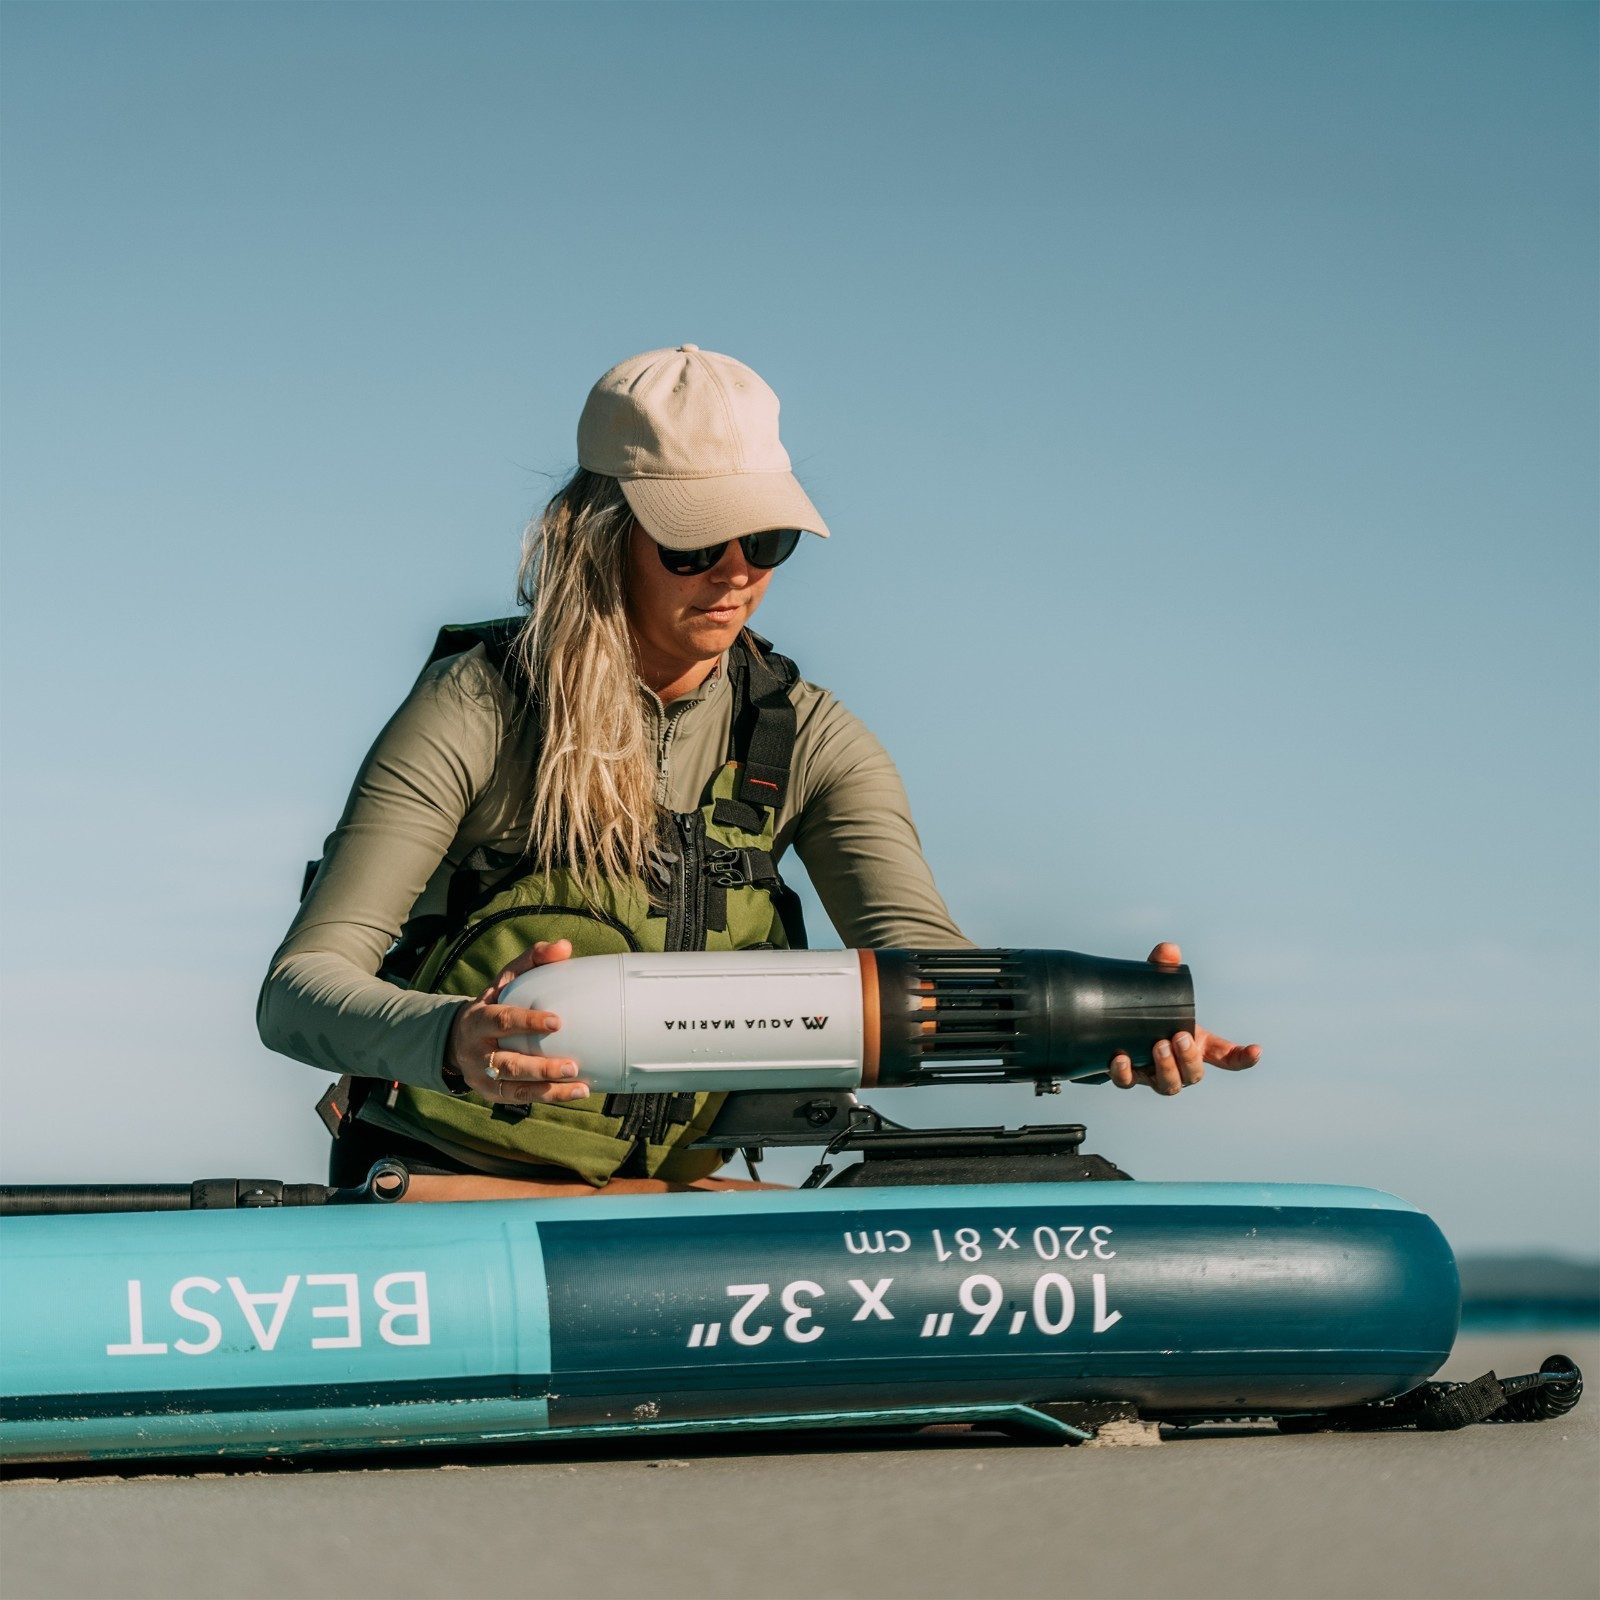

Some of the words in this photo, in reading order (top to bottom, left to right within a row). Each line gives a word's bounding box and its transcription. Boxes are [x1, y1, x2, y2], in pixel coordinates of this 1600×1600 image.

[664, 1019, 736, 1030] MARINA
[744, 1018, 794, 1029] AQUA
[844, 1230, 911, 1255] cm
[932, 1227, 983, 1263] 81
[993, 1226, 1021, 1251] x
[1032, 1225, 1117, 1261] 320
[107, 1271, 431, 1355] BEAST
[687, 1279, 826, 1348] 32"
[848, 1277, 896, 1322] x
